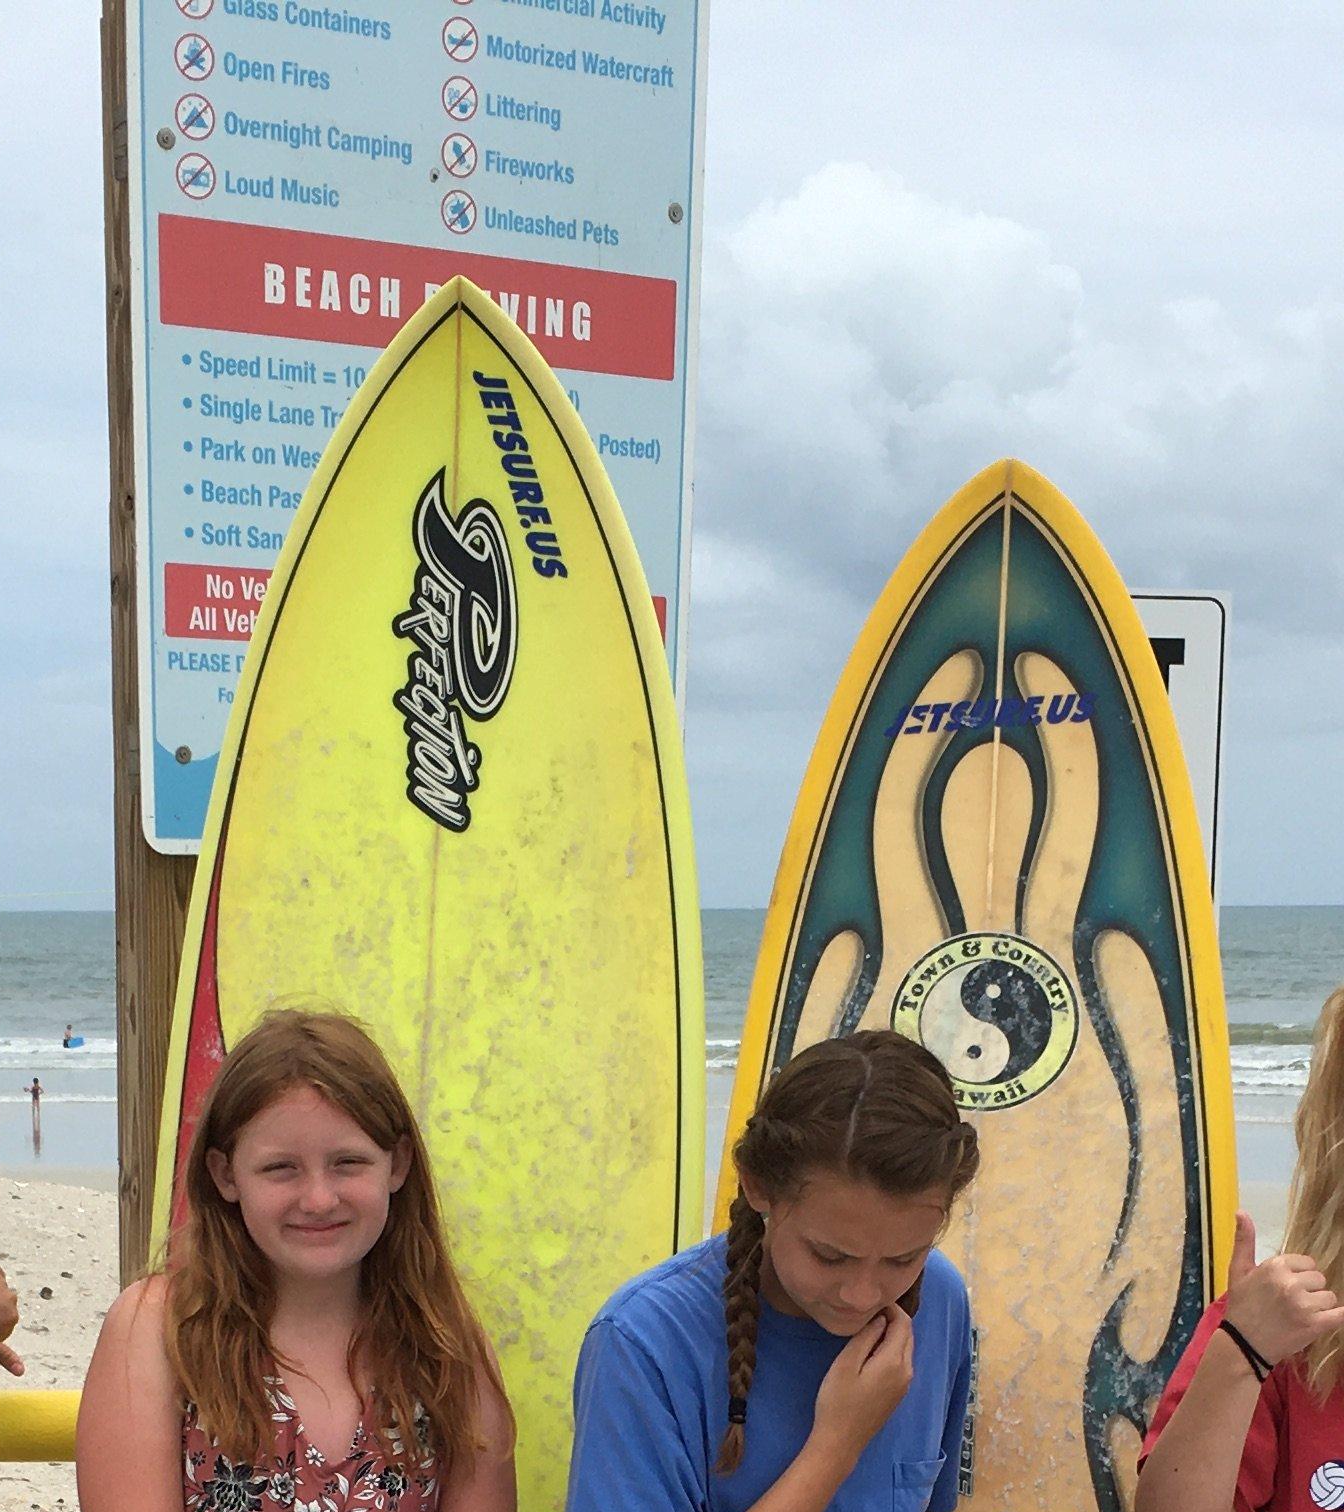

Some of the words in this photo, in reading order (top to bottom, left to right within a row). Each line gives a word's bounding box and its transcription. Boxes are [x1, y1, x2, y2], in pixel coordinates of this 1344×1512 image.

[223, 0, 279, 21] Glass
[284, 2, 391, 40] Containers
[600, 0, 666, 35] Activity
[223, 52, 275, 83] Open
[281, 61, 331, 91] Fires
[486, 34, 576, 71] Motorized
[582, 50, 674, 88] Watercraft
[485, 93, 562, 131] Littering
[224, 111, 322, 149] Overnight
[327, 126, 413, 166] Camping
[485, 150, 575, 185] Fireworks
[224, 170, 274, 199] Loud
[281, 178, 340, 208] Music
[484, 206, 577, 240] Unleashed
[582, 219, 620, 247] Pets
[264, 262, 401, 318] BEACH
[199, 350, 260, 380] Speed
[267, 357, 317, 384] Limit
[343, 365, 366, 389] 10
[200, 393, 262, 425] Single
[268, 401, 315, 426] Lane
[200, 436, 246, 463] Park
[252, 446, 276, 465] on
[599, 433, 661, 464] Posted)
[472, 370, 568, 579] JETSURF.US
[201, 479, 262, 507] Beach
[201, 522, 241, 548] Soft
[247, 525, 286, 551] San
[206, 574, 234, 600] No
[189, 606, 217, 632] All
[167, 651, 231, 673] PLEASE
[899, 952, 956, 1013] Town
[961, 940, 981, 958] &
[991, 940, 1070, 1016] Country
[953, 1078, 1028, 1105] awaii
